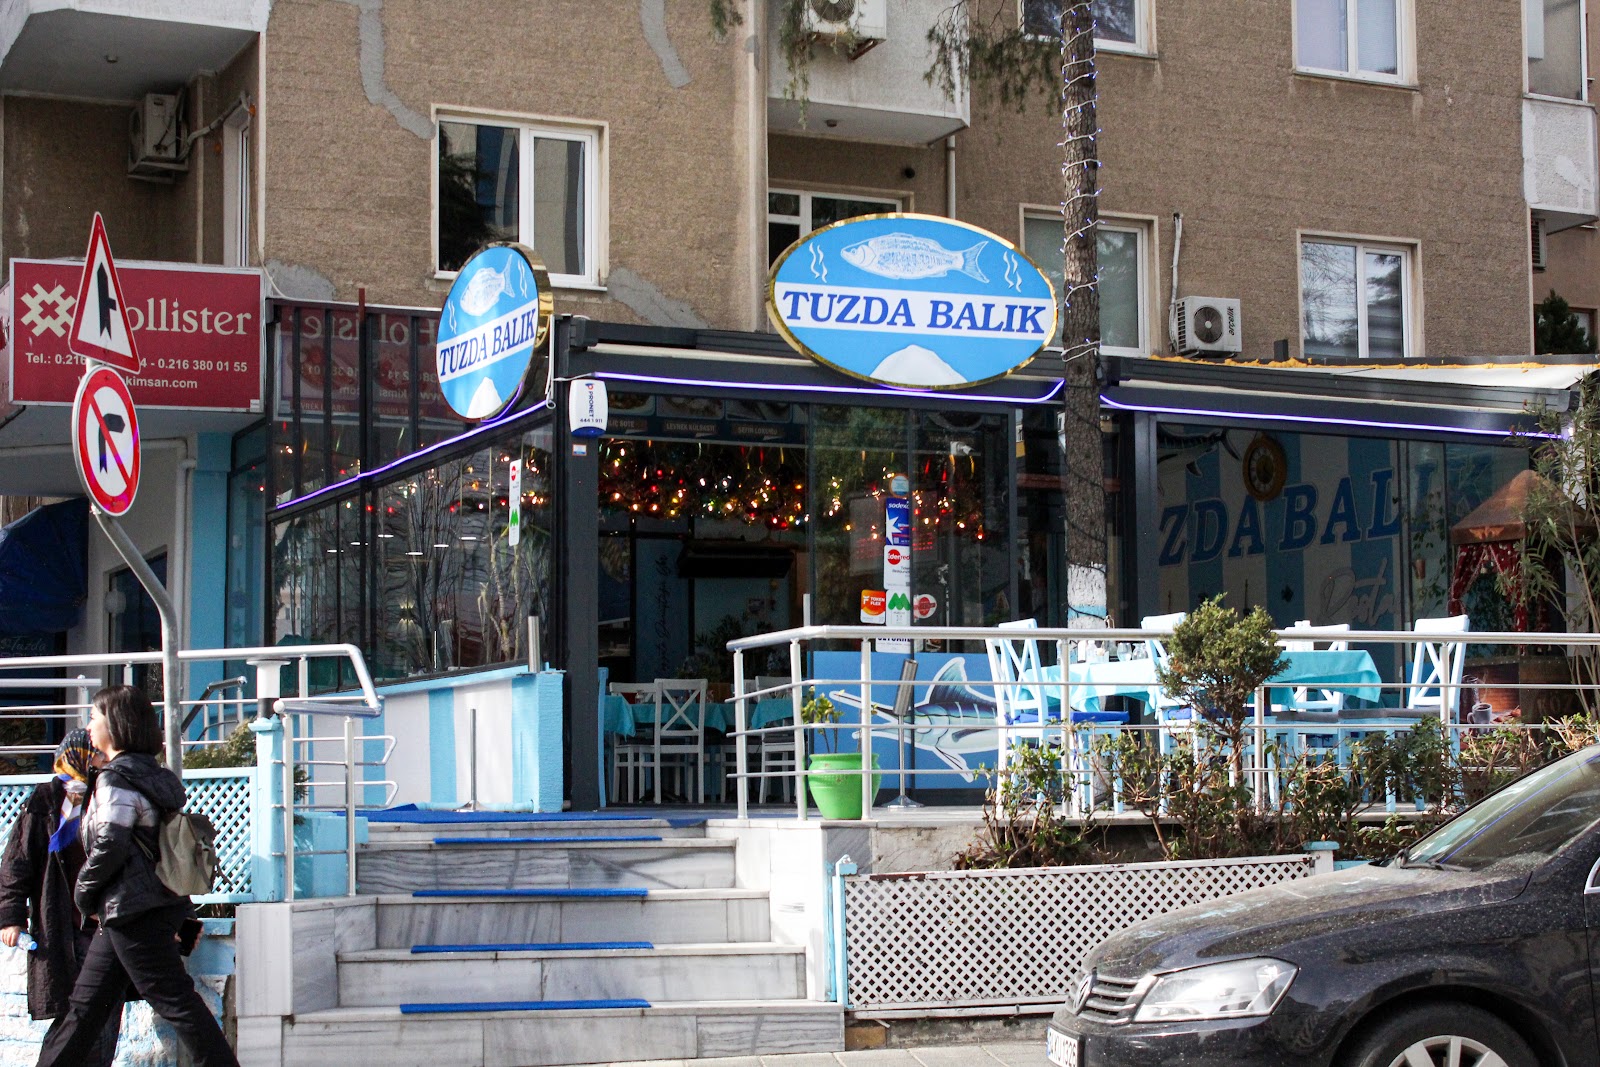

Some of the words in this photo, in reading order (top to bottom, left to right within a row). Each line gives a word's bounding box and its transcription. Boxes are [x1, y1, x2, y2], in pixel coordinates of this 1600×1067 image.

[125, 297, 252, 335] ollister
[783, 291, 915, 327] TUZDA
[927, 300, 1047, 334] BALIK
[25, 352, 51, 364] Tel.:
[54, 353, 87, 365] 0.216
[157, 358, 189, 370] 0.216
[192, 360, 213, 371] 380
[216, 360, 229, 372] 01
[233, 361, 248, 372] 55
[440, 336, 488, 377] TUZDA
[491, 308, 538, 357] BALIK
[124, 375, 198, 389] kimsan.com
[1158, 496, 1264, 567] ZDA
